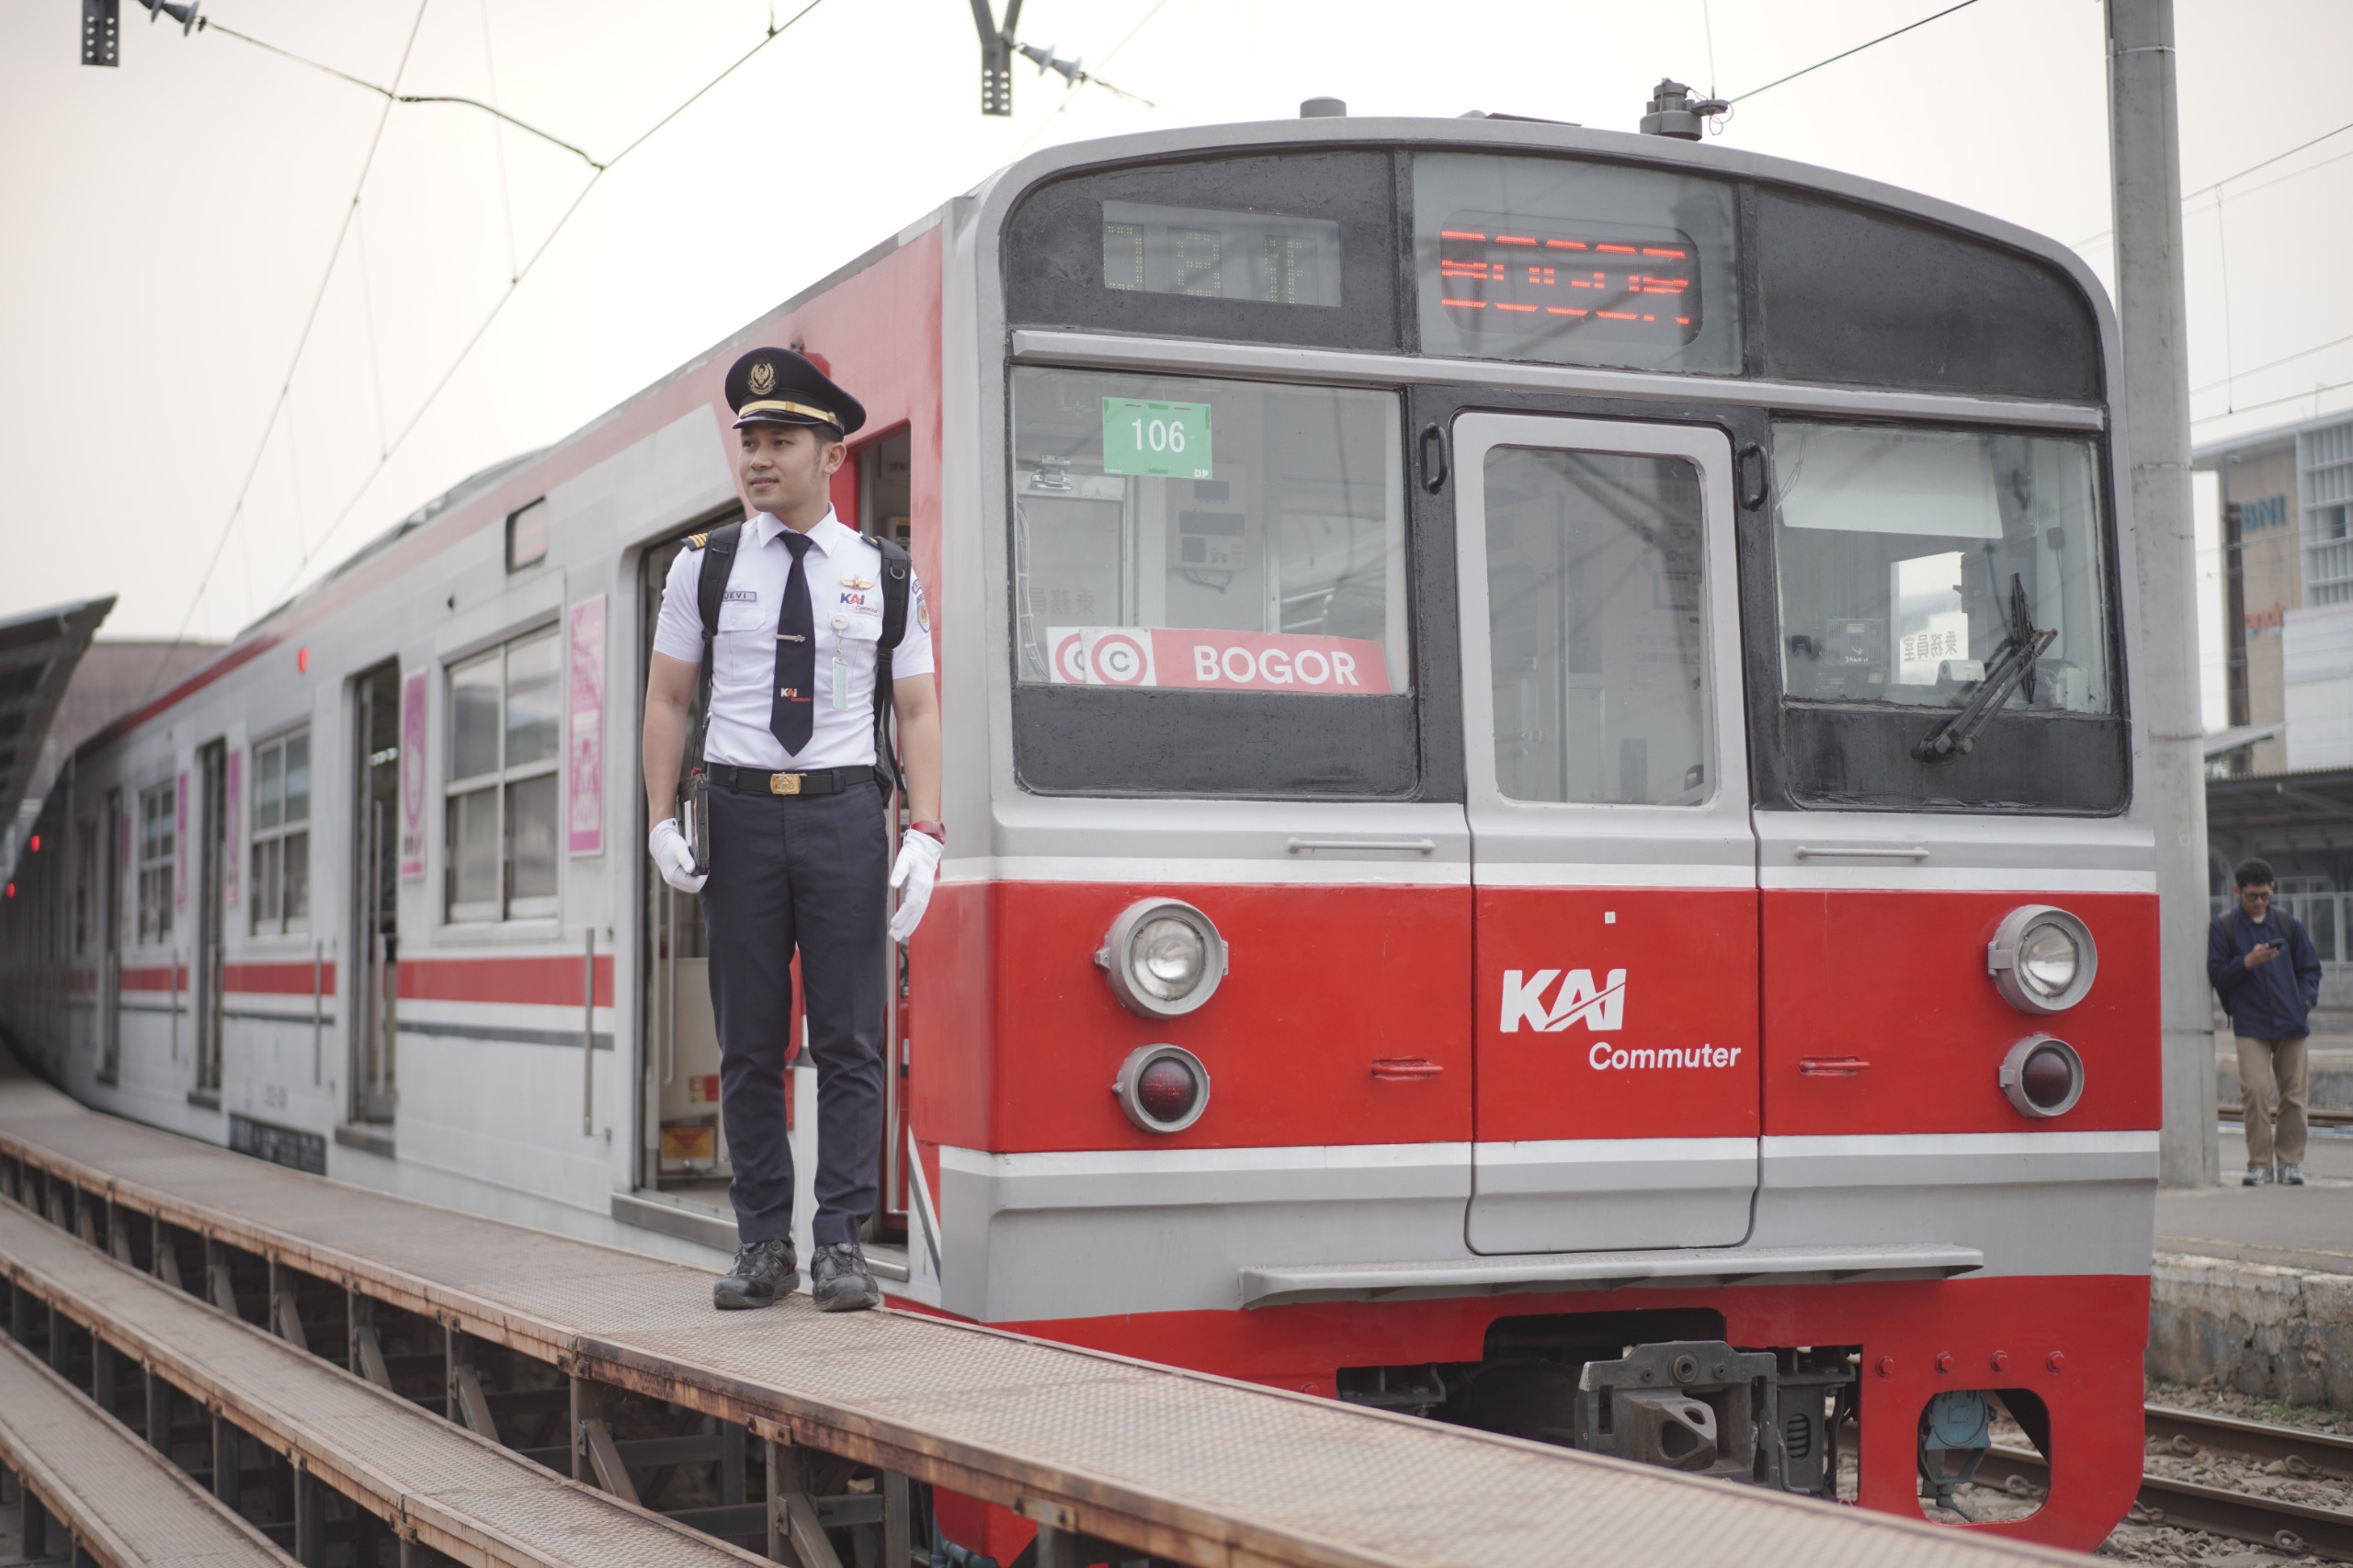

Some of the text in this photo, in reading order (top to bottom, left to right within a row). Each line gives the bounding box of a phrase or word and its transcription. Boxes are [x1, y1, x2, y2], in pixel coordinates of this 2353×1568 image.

[1131, 418, 1186, 453] 106
[1194, 469, 1209, 478] DP
[840, 593, 865, 605] KAI
[1193, 645, 1359, 686] BOGOR
[780, 687, 797, 698] KAI
[1499, 968, 1627, 1033] KAI
[1589, 1041, 1742, 1071] Commuter
